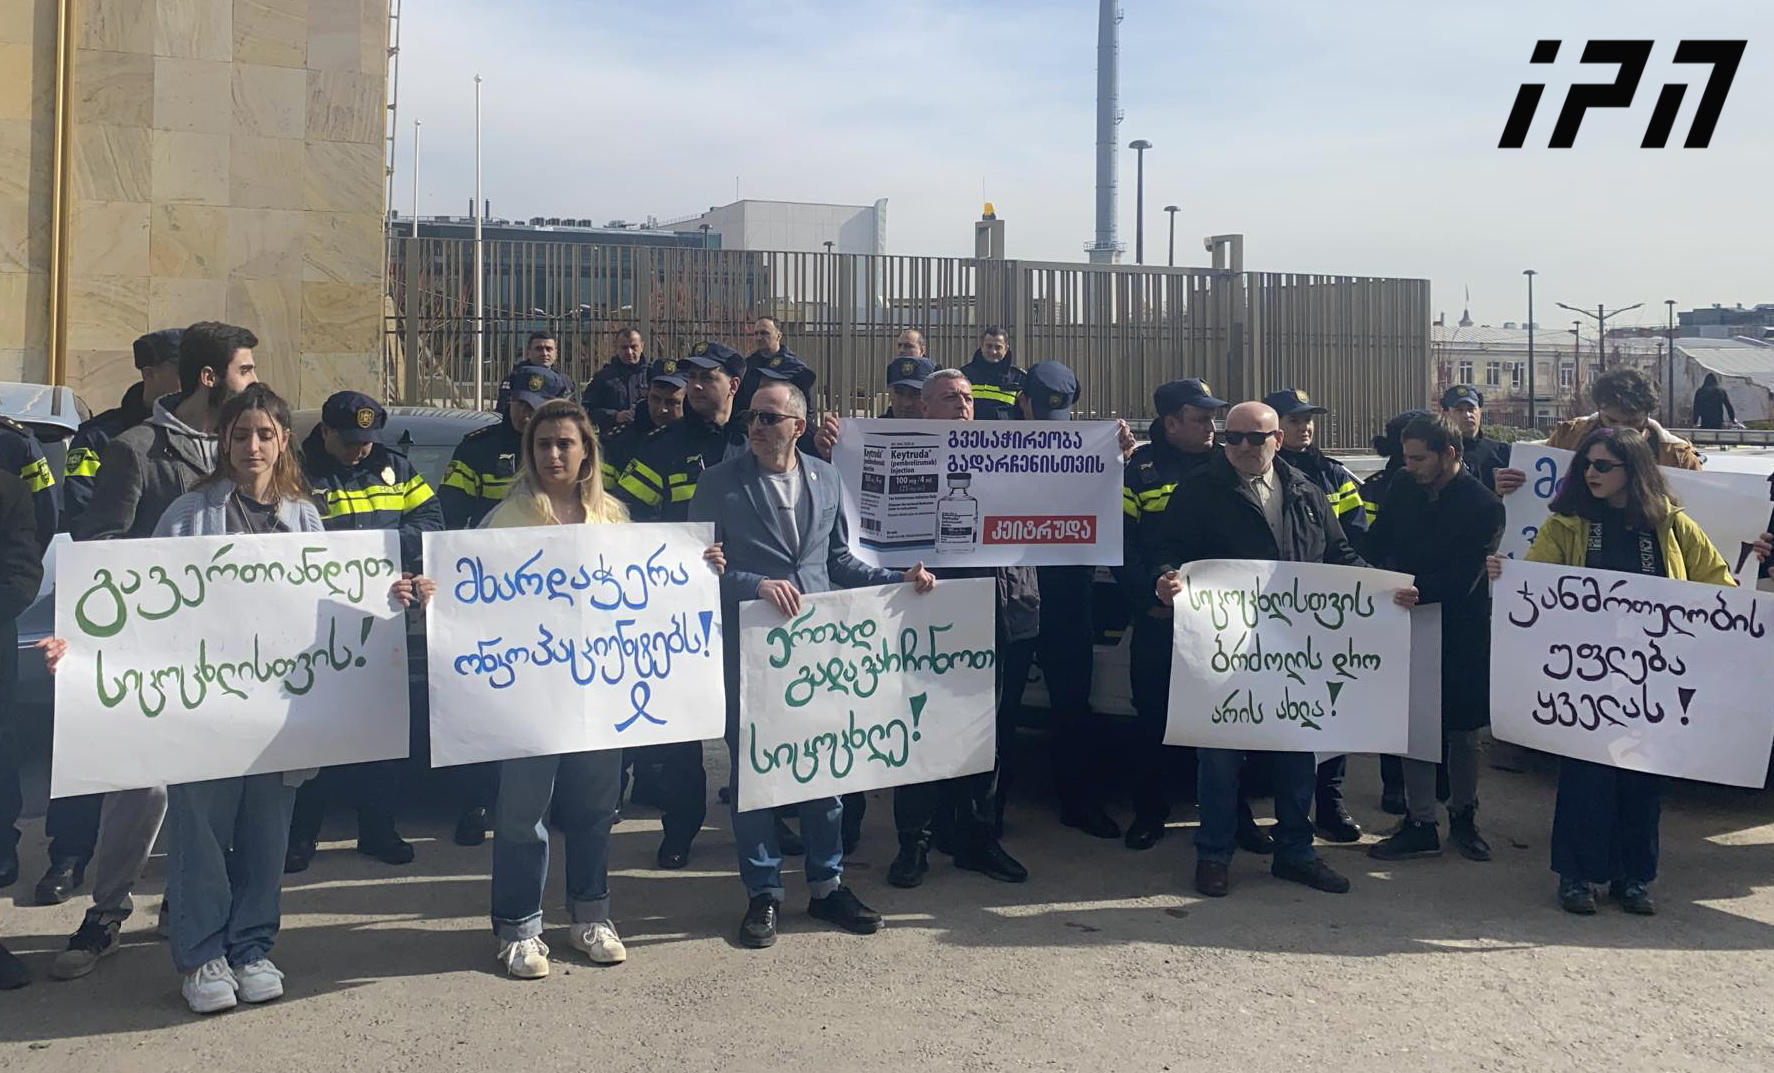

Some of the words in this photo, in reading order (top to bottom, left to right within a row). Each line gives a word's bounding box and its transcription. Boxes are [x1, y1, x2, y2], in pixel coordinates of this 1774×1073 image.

[947, 454, 1105, 473] გადარჩენისთვის
[991, 520, 1091, 540] კეიტრუდა
[75, 543, 394, 638] გავერთიანდეთ
[454, 543, 690, 610] მხარდაჭერა
[1187, 575, 1375, 630] სიცოცხლისთვის
[1508, 575, 1765, 638] ჯანმრთელობის
[96, 616, 375, 718] სიცოცხლისთვის!
[454, 611, 713, 689] ონკოპაციენტებს!
[766, 603, 876, 669] ერთად
[785, 622, 996, 707] გადავარჩინოთ
[1211, 631, 1323, 685] ბრძოლის
[1332, 636, 1382, 680] დრო
[1543, 640, 1687, 685] უფლება
[750, 692, 928, 784] სიცოცხლე!
[1211, 689, 1264, 724] არის
